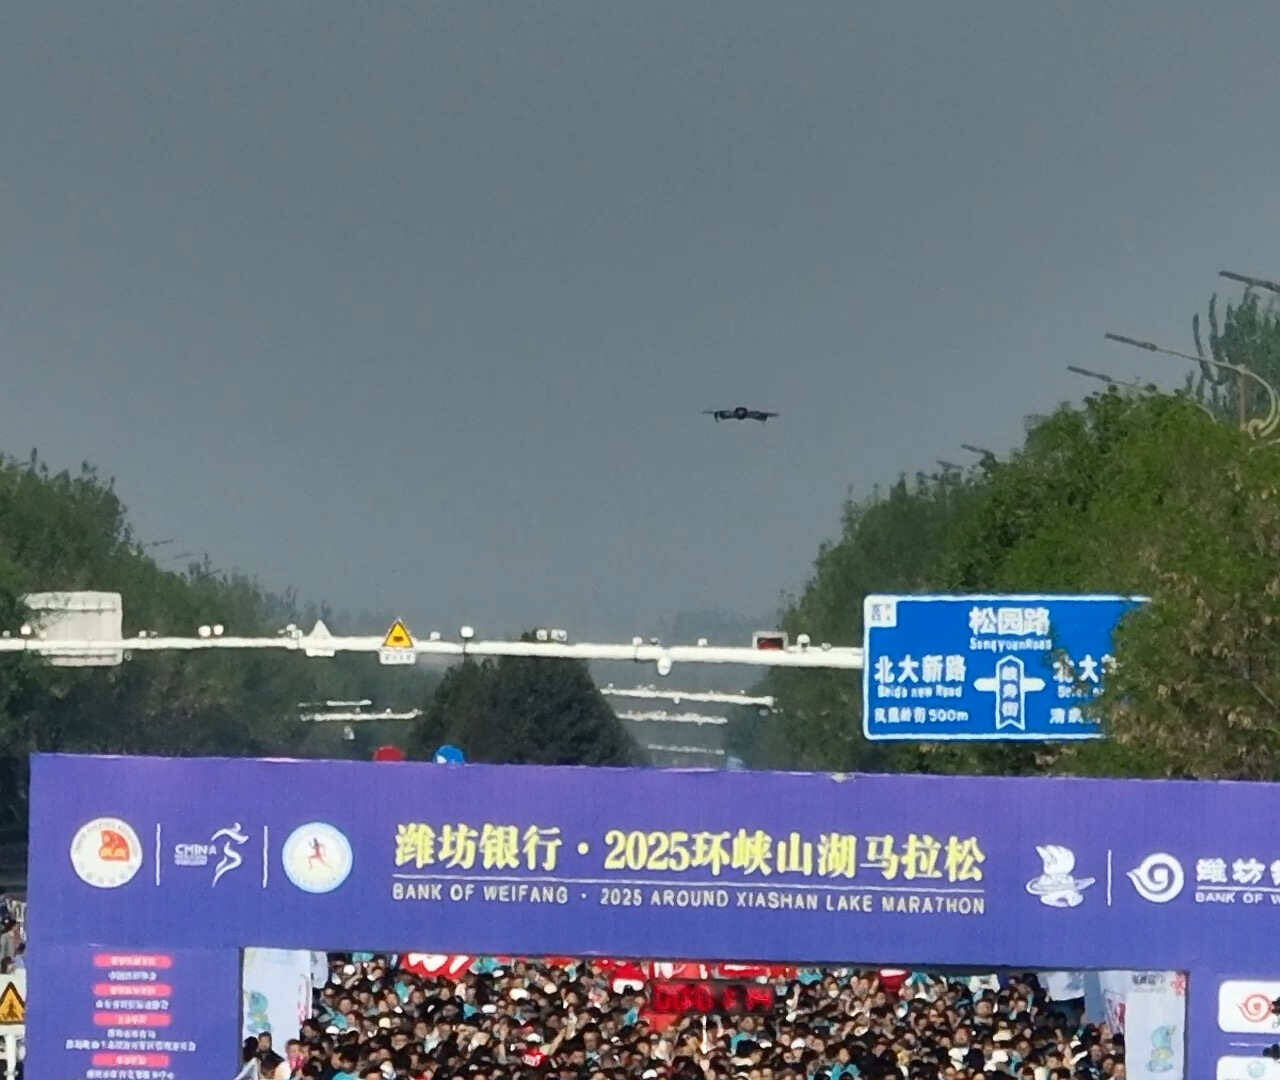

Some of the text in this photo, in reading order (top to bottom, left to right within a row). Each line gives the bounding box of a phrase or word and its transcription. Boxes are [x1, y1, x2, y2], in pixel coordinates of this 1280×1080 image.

[969, 606, 1050, 636] 松园路
[874, 654, 966, 683] 北大新路
[175, 843, 217, 856] CHINA
[393, 884, 985, 915] BANK OF WEIFANG 2025 AROUND XIASHAN LAKE MARATHON
[1195, 891, 1236, 904] BANK
[1242, 892, 1264, 904] OF
